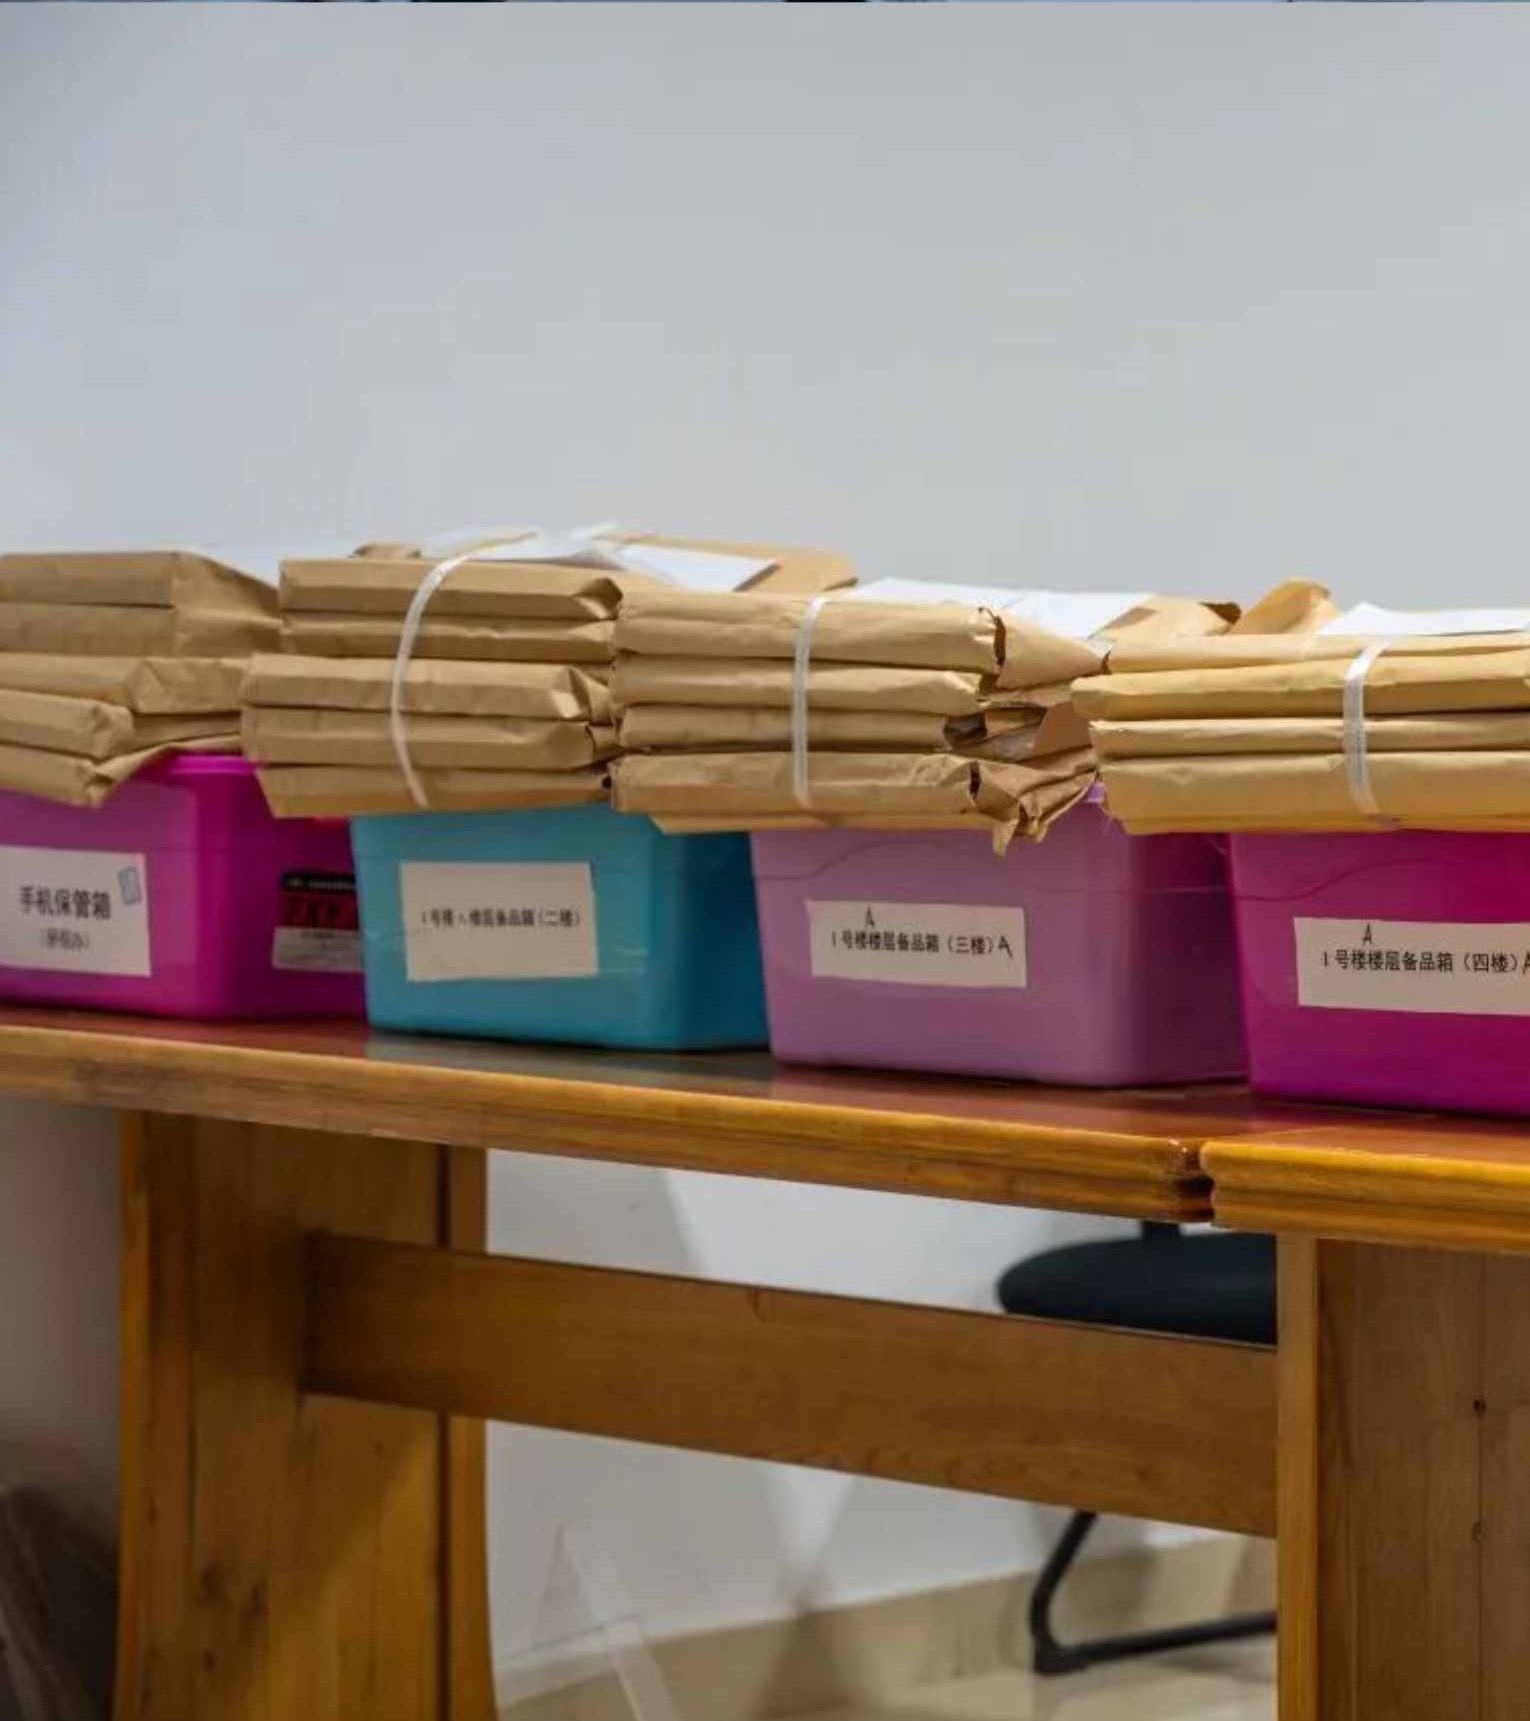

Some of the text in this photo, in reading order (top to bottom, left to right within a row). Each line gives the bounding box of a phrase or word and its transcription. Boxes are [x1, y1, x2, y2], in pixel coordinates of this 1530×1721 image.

[20, 885, 112, 920] 手机保管箱
[1361, 923, 1374, 946] A
